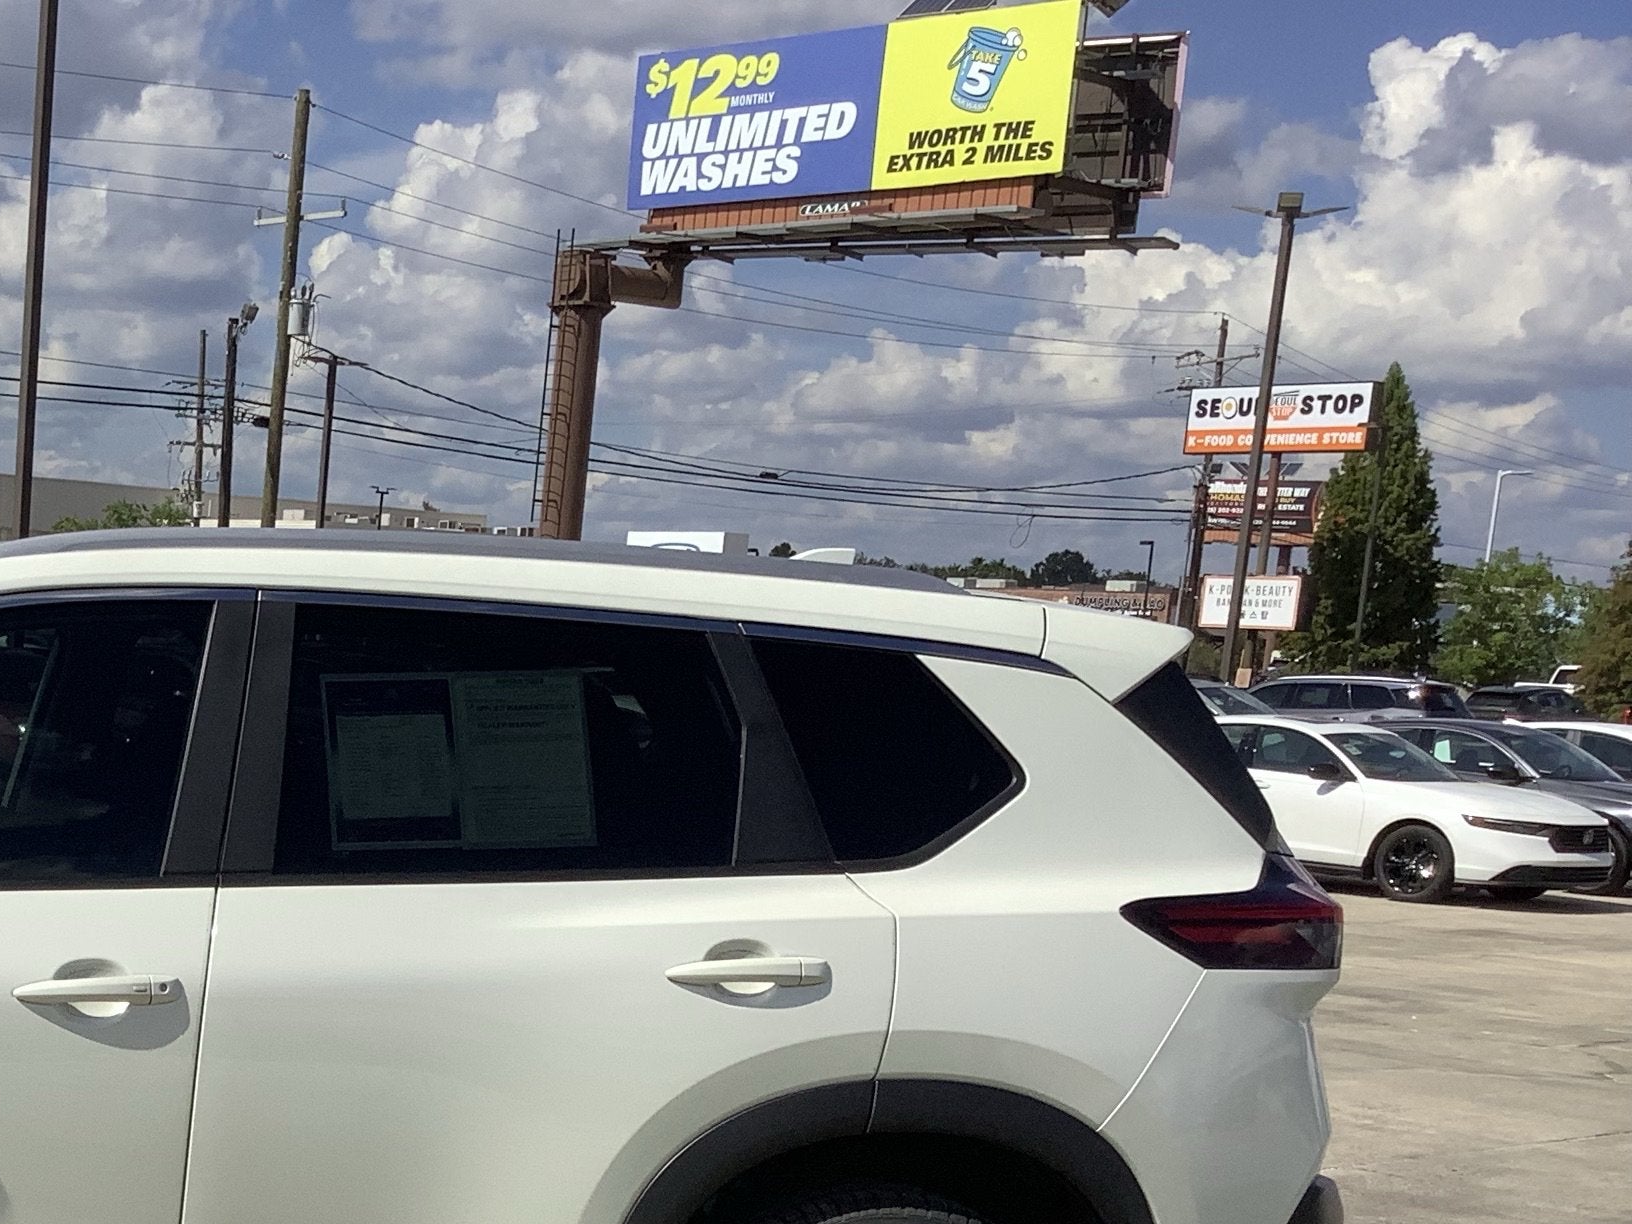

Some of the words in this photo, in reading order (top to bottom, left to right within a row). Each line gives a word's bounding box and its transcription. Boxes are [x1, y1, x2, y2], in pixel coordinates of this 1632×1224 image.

[971, 49, 1002, 64] TAKE
[961, 61, 998, 97] 5
[730, 91, 775, 108] MONTHLY
[641, 101, 858, 159] UNLIMITED
[908, 124, 986, 150] WORTH
[993, 120, 1035, 141] THE
[886, 149, 955, 173] EXTRA
[962, 147, 977, 165] 2
[983, 141, 1054, 164] MILES
[639, 145, 801, 196] WASHES
[1271, 396, 1297, 406] EOUL
[1300, 393, 1364, 415] STOP
[1187, 434, 1234, 447] K-FOOD
[1237, 431, 1318, 446] COVENIENCE
[1322, 430, 1364, 444] STORE
[1209, 493, 1245, 502] HOMAS
[1208, 584, 1232, 595] K-PO
[1074, 596, 1130, 609] DUMPLING
